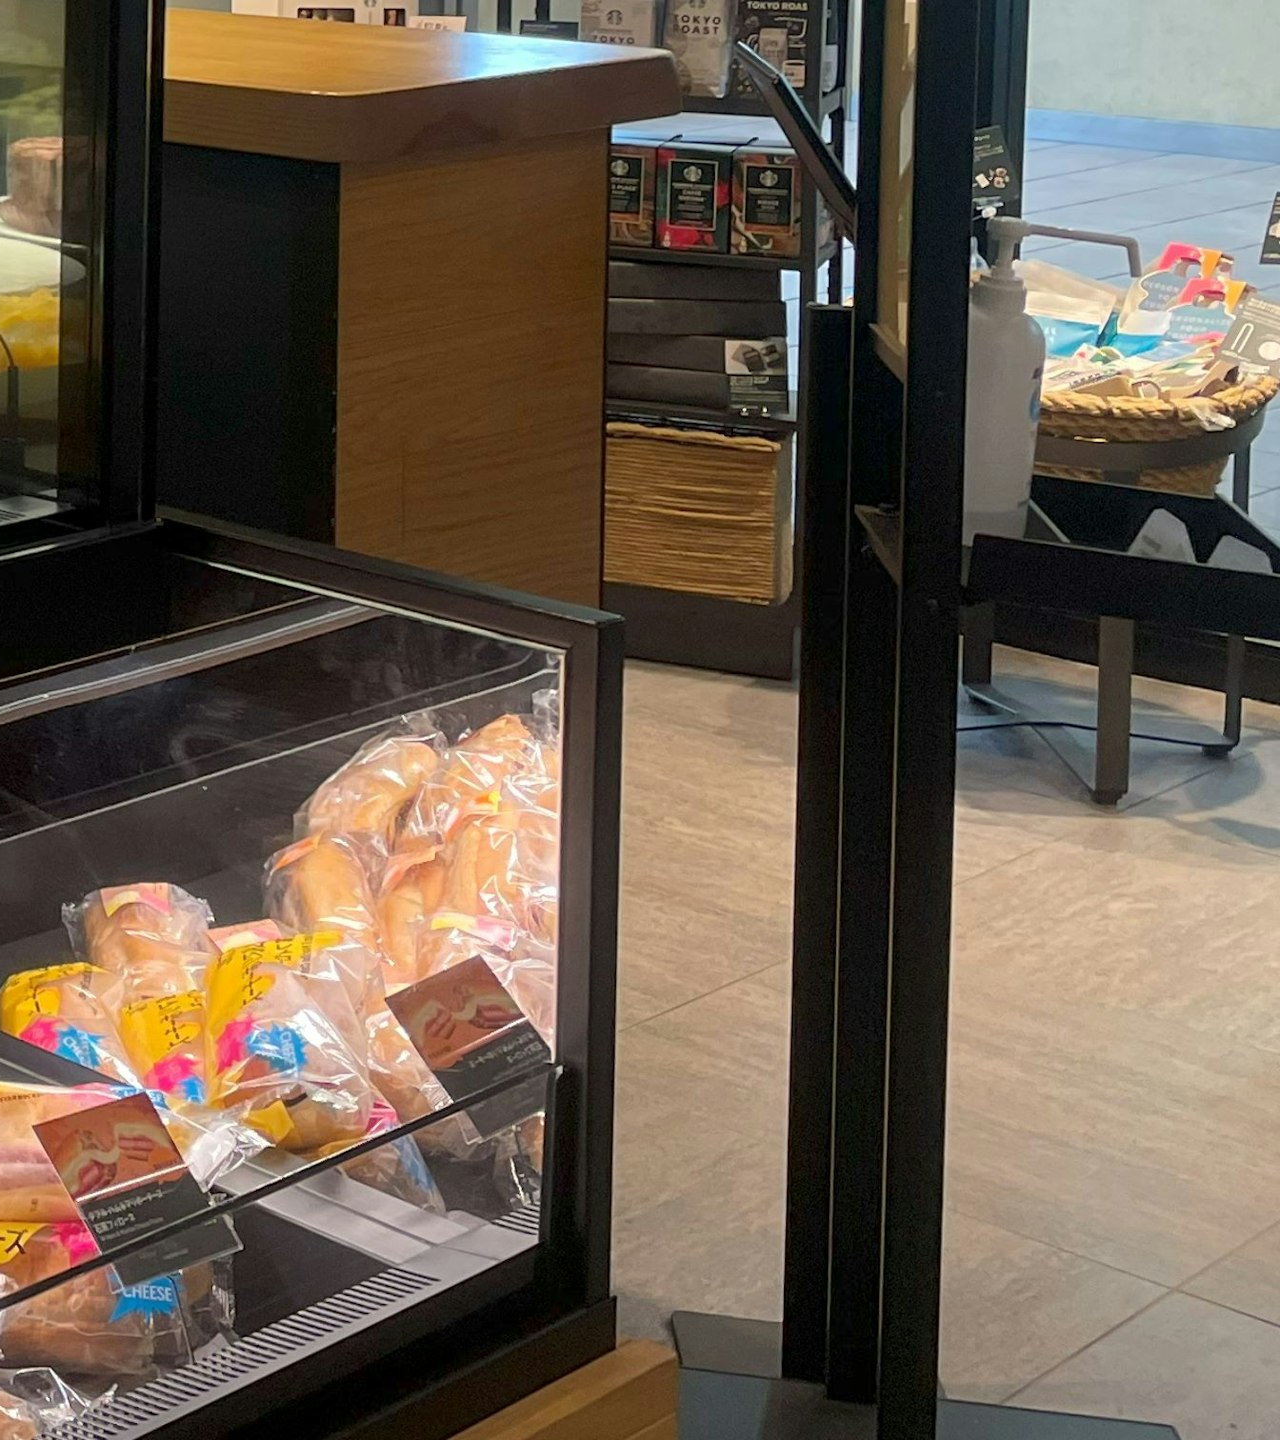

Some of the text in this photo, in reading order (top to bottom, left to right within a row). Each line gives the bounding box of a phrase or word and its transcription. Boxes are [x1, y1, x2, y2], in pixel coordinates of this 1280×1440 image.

[746, 0, 780, 10] TOKYO
[674, 14, 721, 25] TOKYO
[673, 26, 720, 35] ROAST
[592, 34, 635, 45] TOKYO
[122, 1285, 173, 1302] CHEESE
